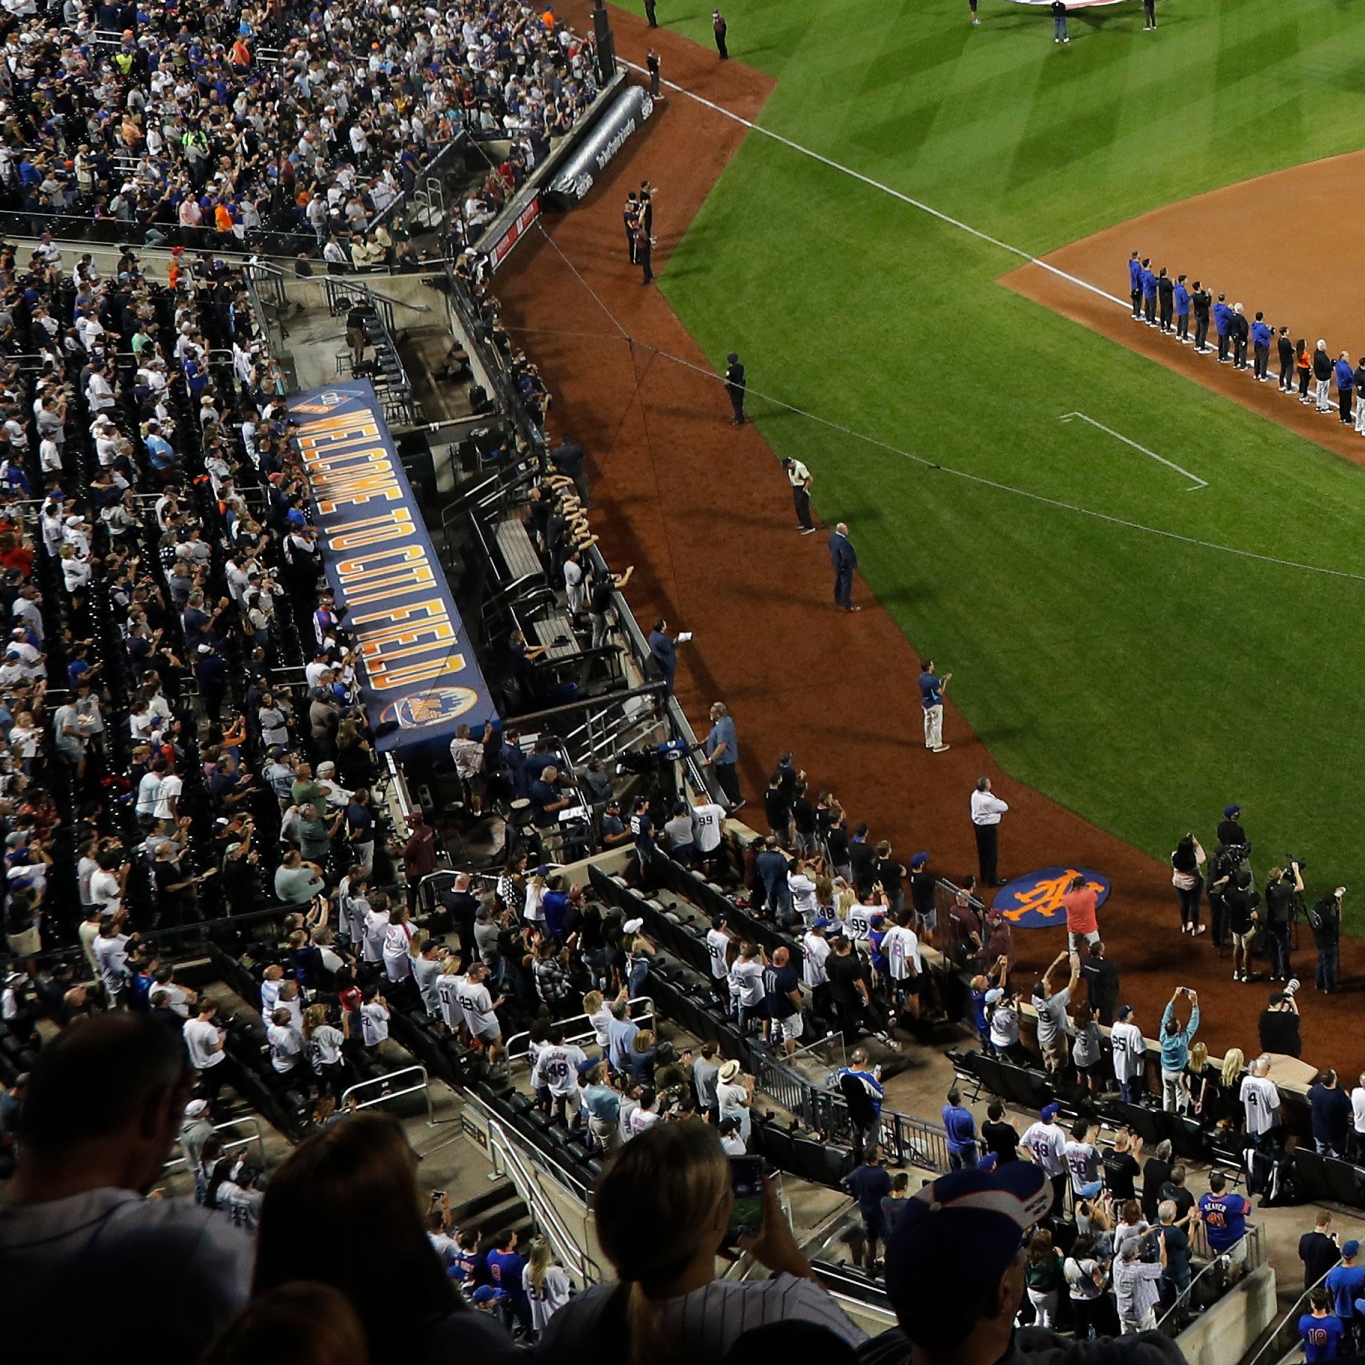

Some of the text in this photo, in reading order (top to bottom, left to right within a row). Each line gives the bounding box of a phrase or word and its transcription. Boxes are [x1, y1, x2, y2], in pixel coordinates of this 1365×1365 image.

[297, 408, 467, 691] WELCOME TO CITI FIELD
[699, 814, 713, 827] 99
[852, 918, 868, 934] 99
[547, 1062, 569, 1078] 48
[1032, 1140, 1050, 1158] 48
[1204, 1202, 1228, 1213] SEAVER
[1206, 1212, 1227, 1229] 41
